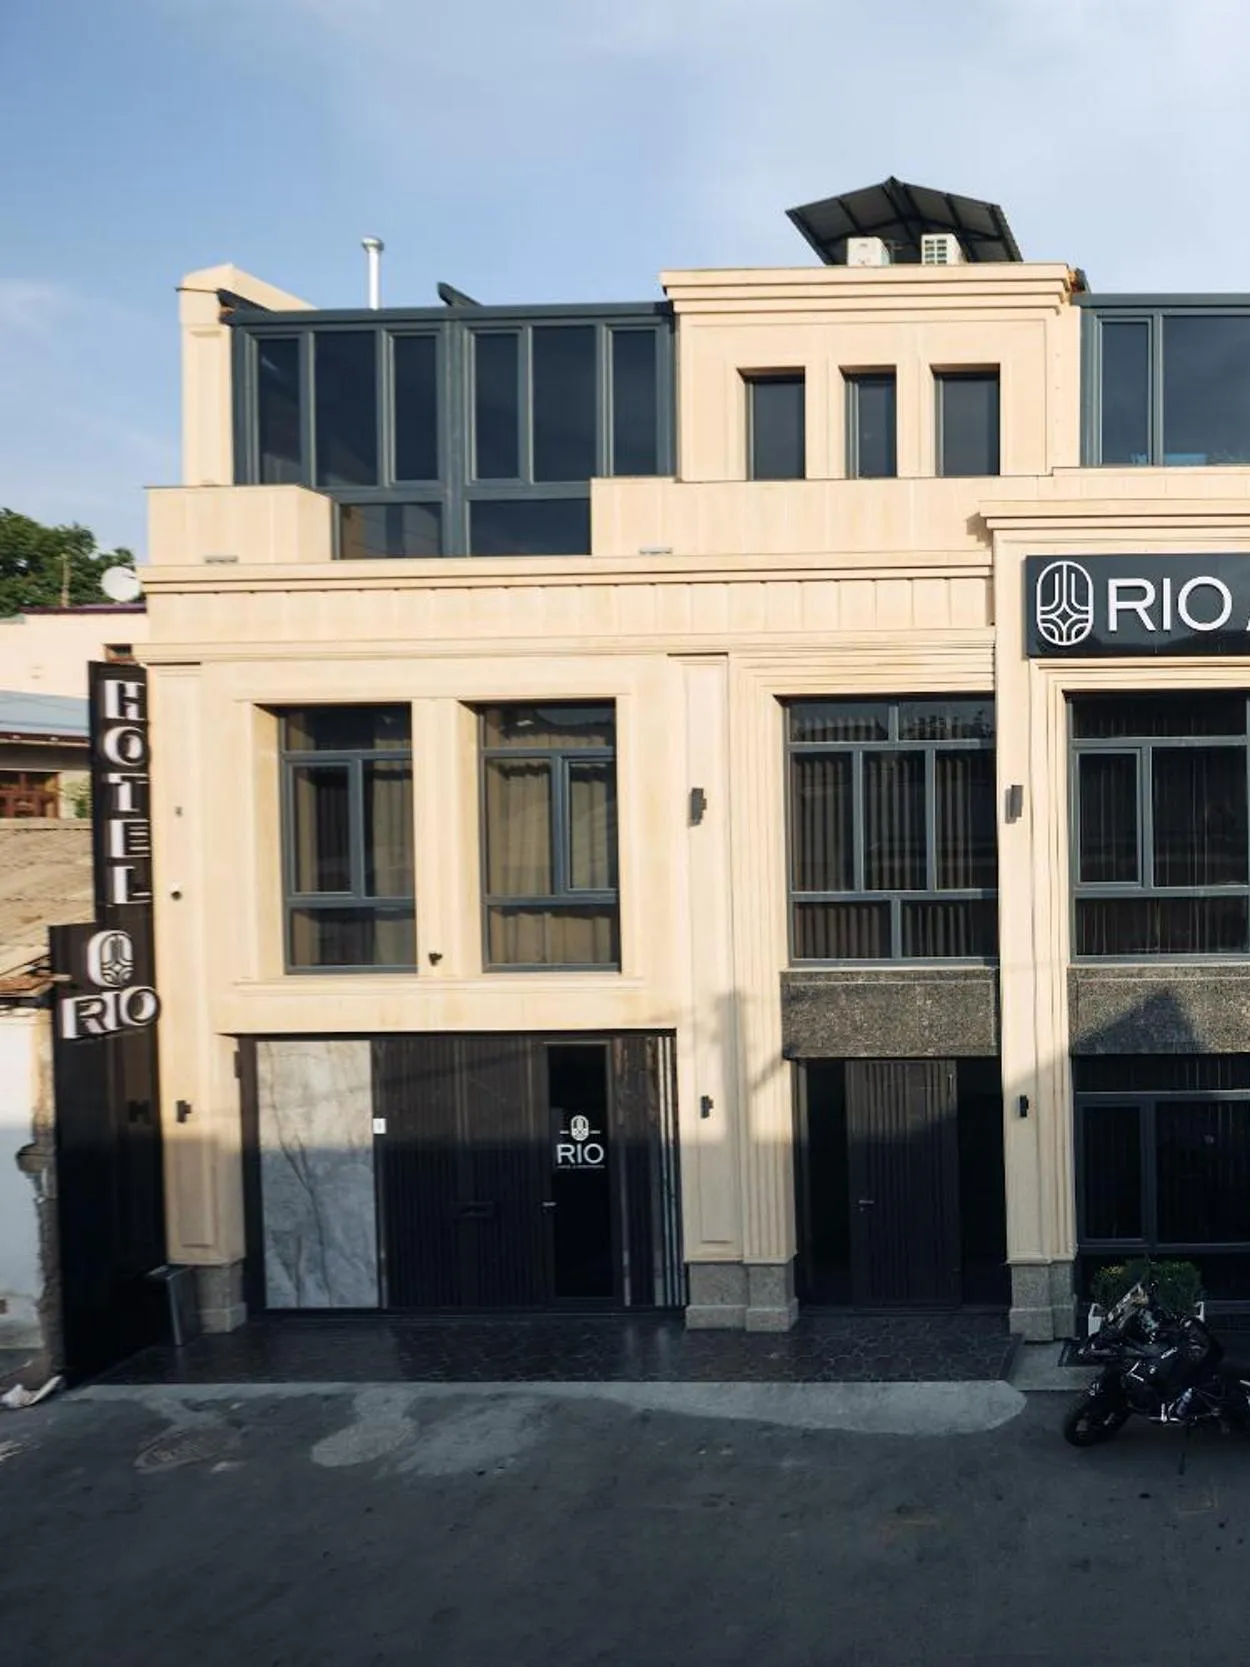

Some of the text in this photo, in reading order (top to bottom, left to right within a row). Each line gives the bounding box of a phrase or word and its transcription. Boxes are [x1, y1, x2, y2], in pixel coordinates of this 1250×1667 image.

[1107, 576, 1233, 632] RIO
[102, 678, 152, 905] HOTEL
[60, 985, 161, 1040] RIO
[556, 1143, 604, 1164] RIO
